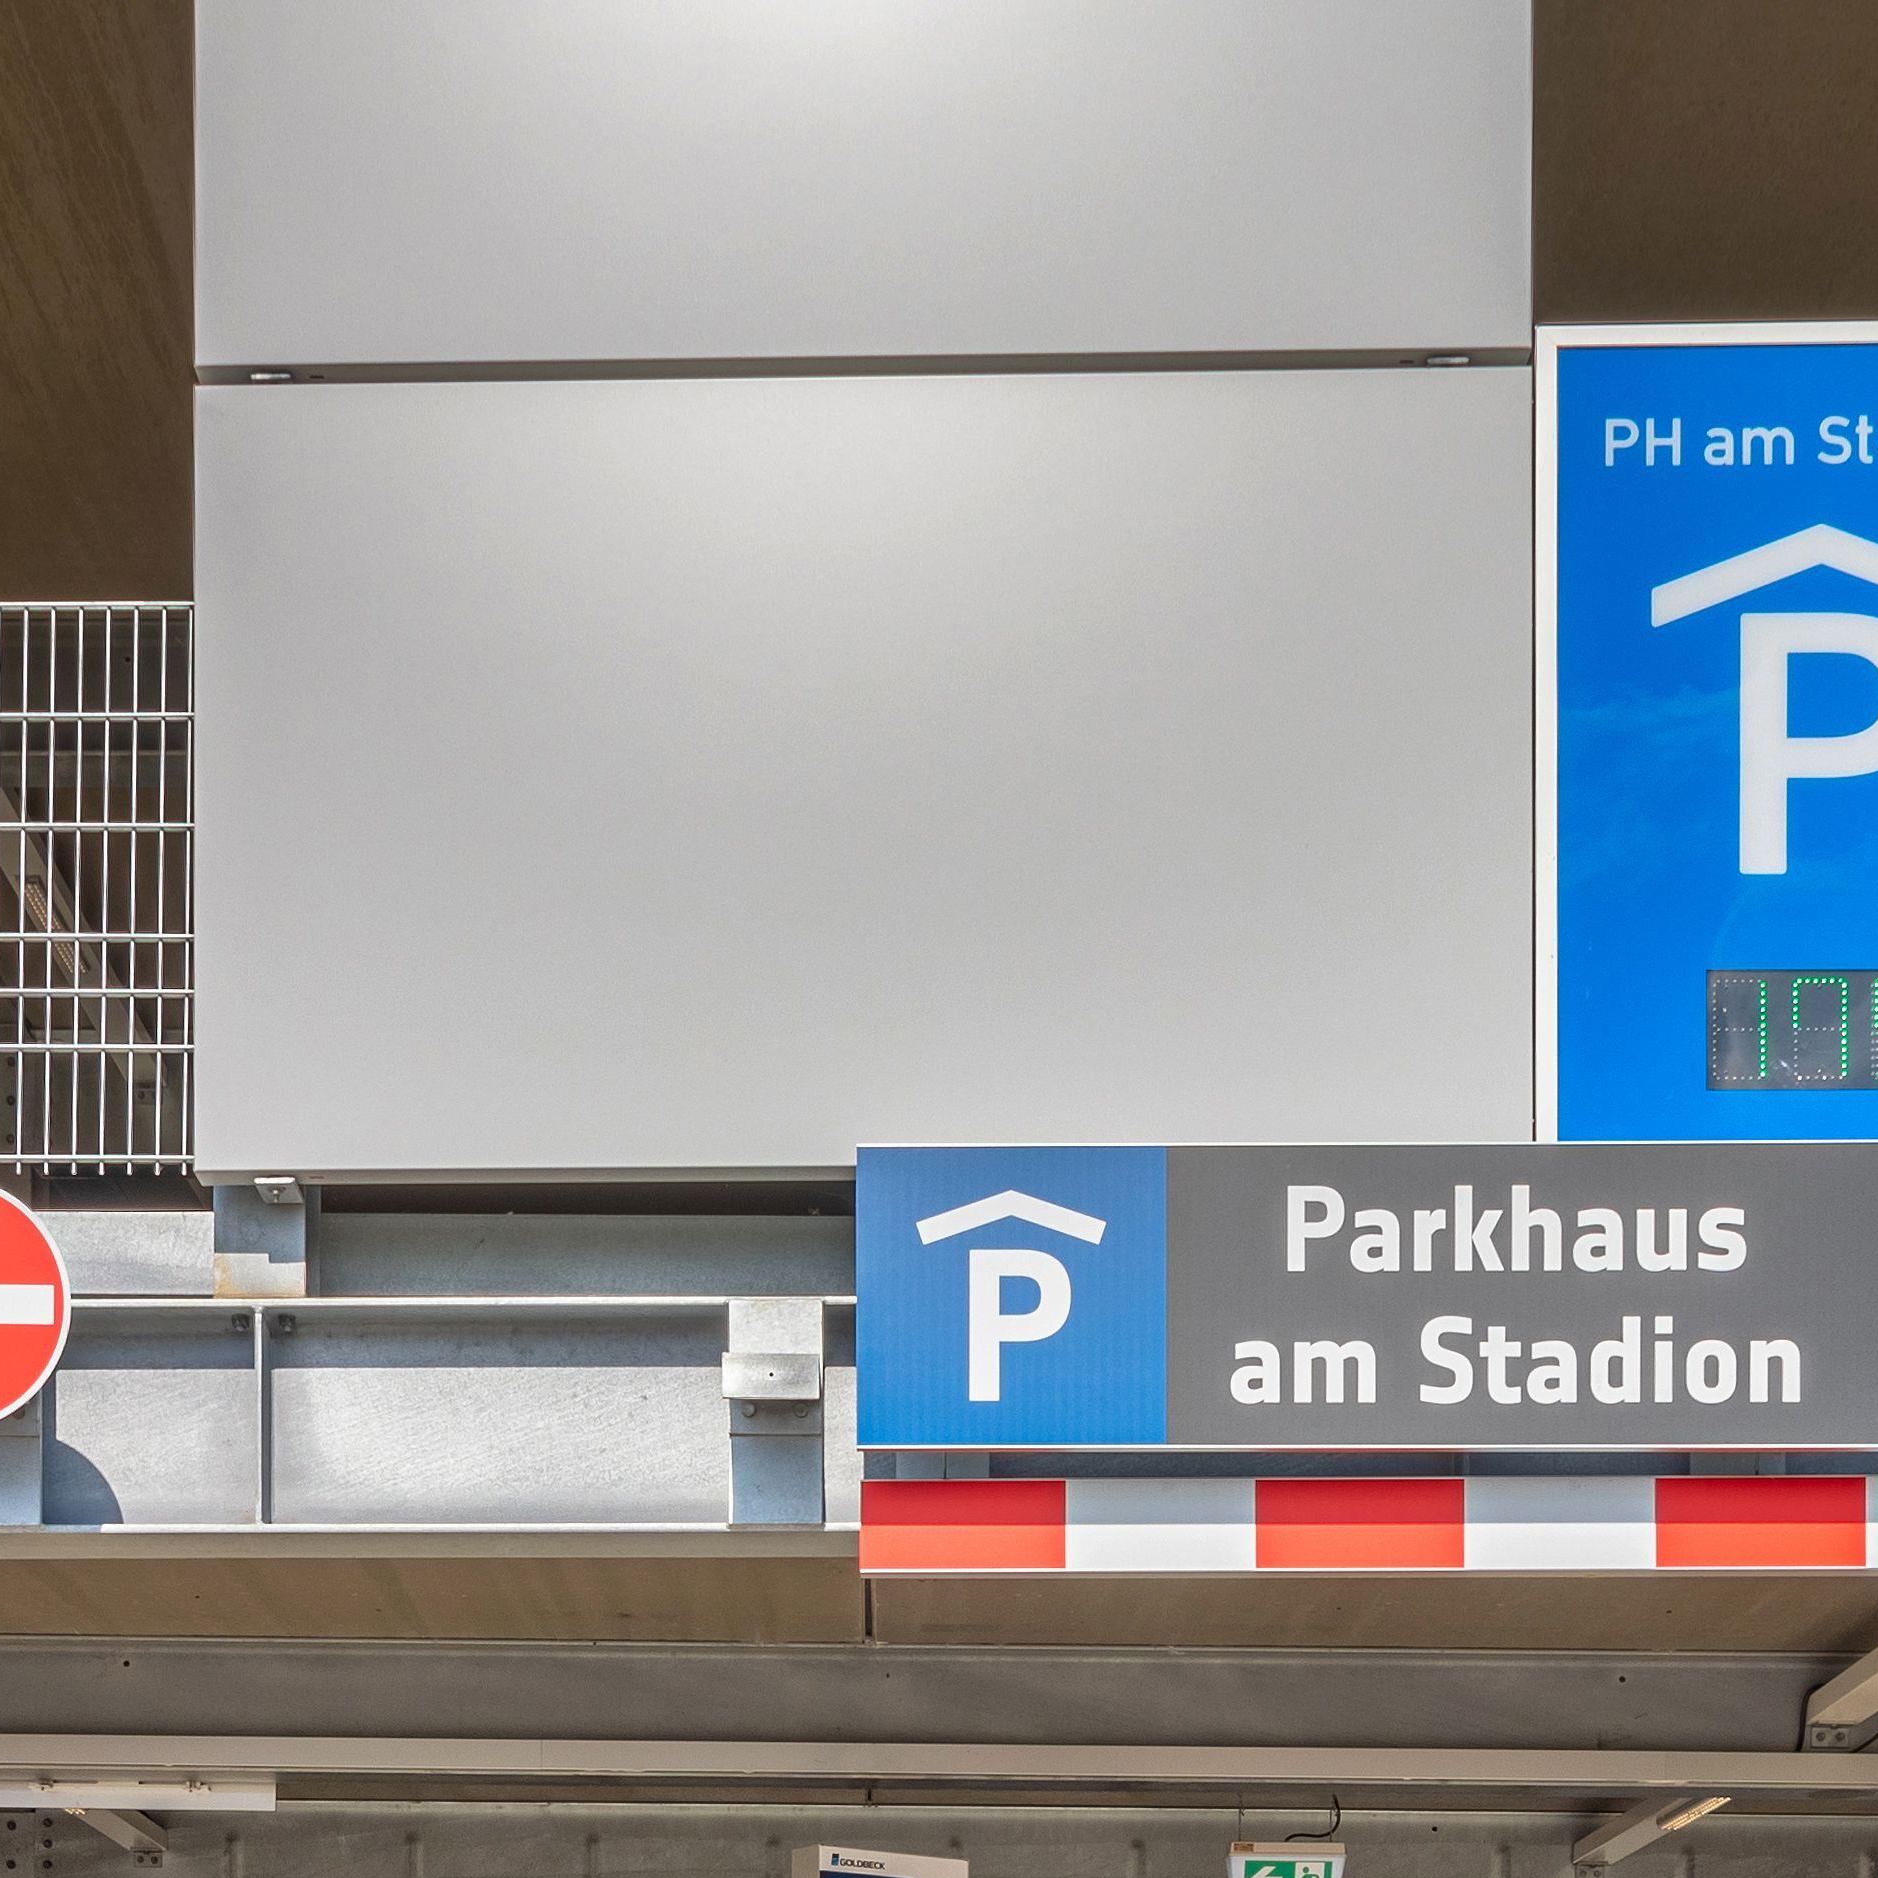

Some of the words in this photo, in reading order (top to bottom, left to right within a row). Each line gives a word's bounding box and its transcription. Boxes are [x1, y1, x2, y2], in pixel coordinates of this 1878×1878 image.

[1605, 418, 1681, 466] PH
[1704, 427, 1794, 465] am
[1284, 1184, 1749, 1273] Parkhaus
[969, 1249, 1071, 1401] P
[1230, 1338, 1377, 1405] am
[1418, 1315, 1802, 1405] Stadion
[839, 1858, 885, 1870] GOLDBECK
